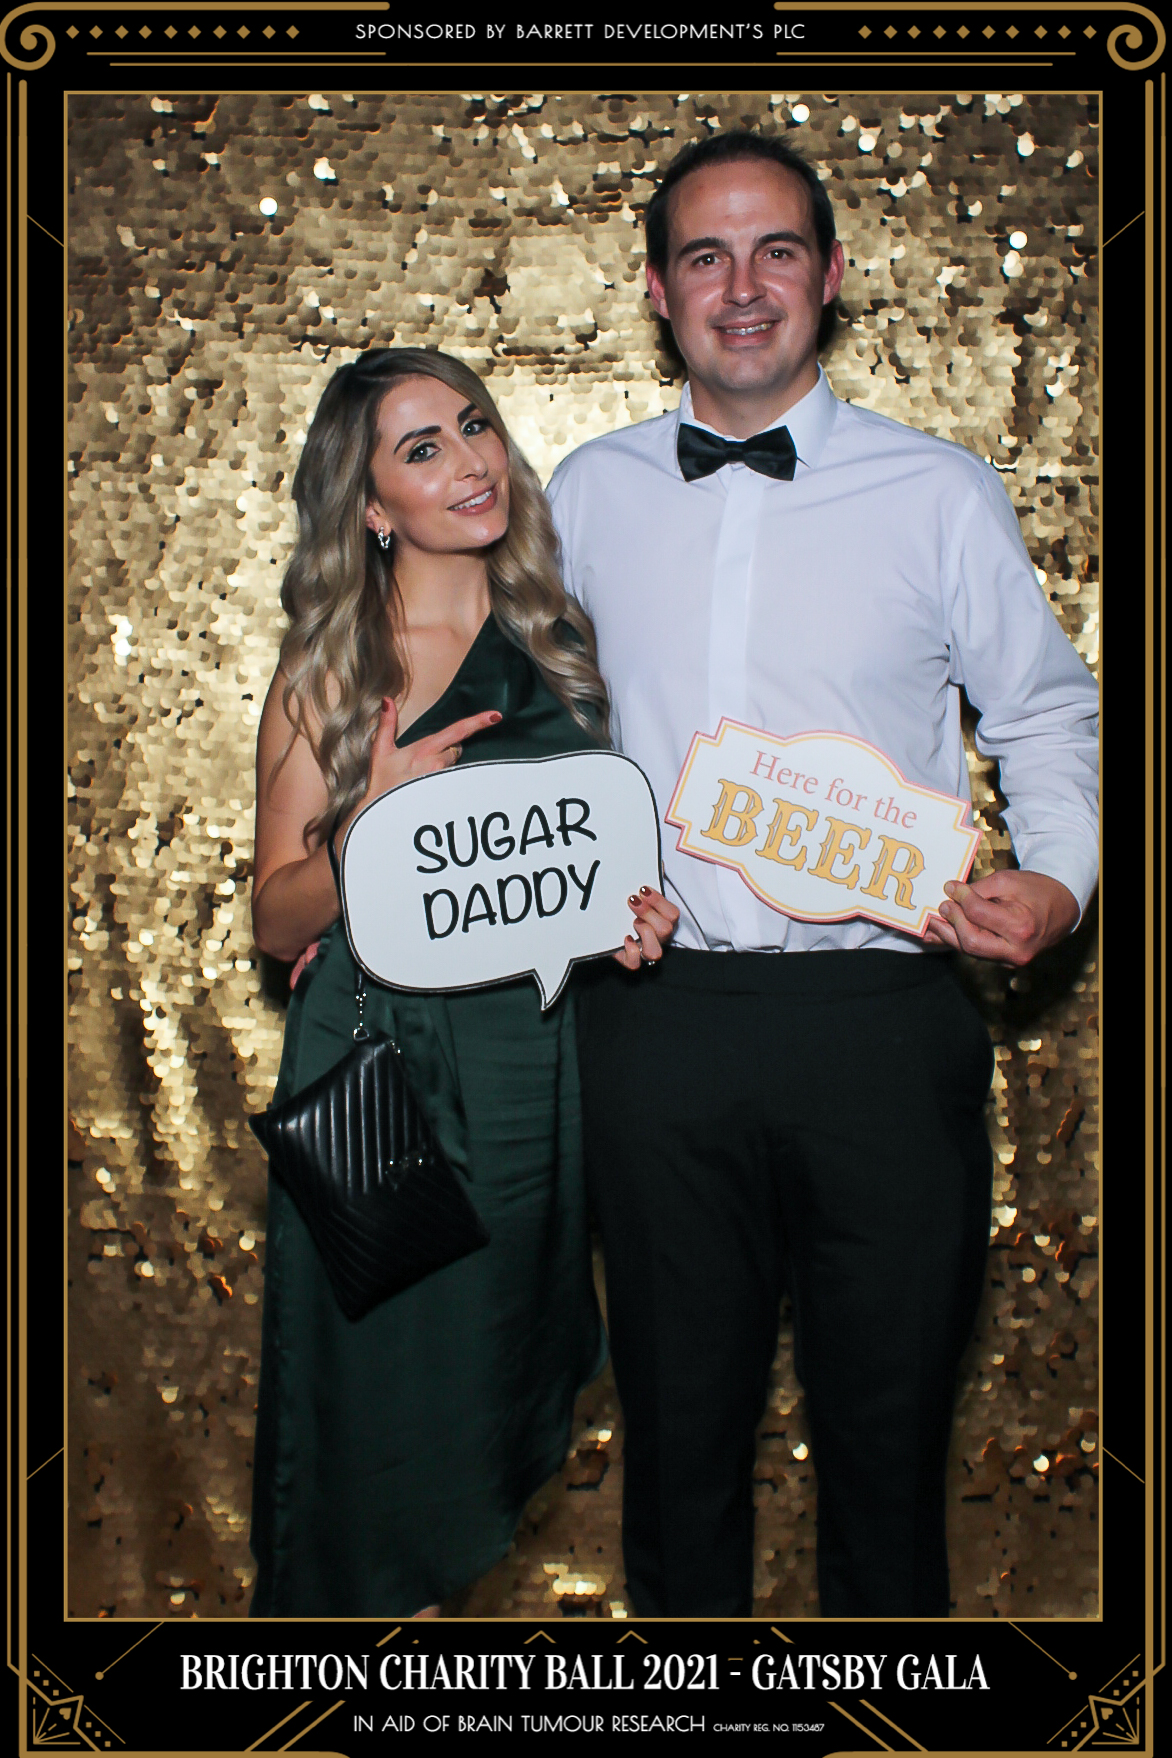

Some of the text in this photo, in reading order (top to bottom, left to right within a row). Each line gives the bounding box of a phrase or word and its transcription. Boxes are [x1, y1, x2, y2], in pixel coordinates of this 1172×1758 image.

[750, 750, 917, 829] Here for the
[413, 797, 597, 874] SUGAR
[700, 778, 926, 910] BEER
[422, 859, 601, 940] DADDY
